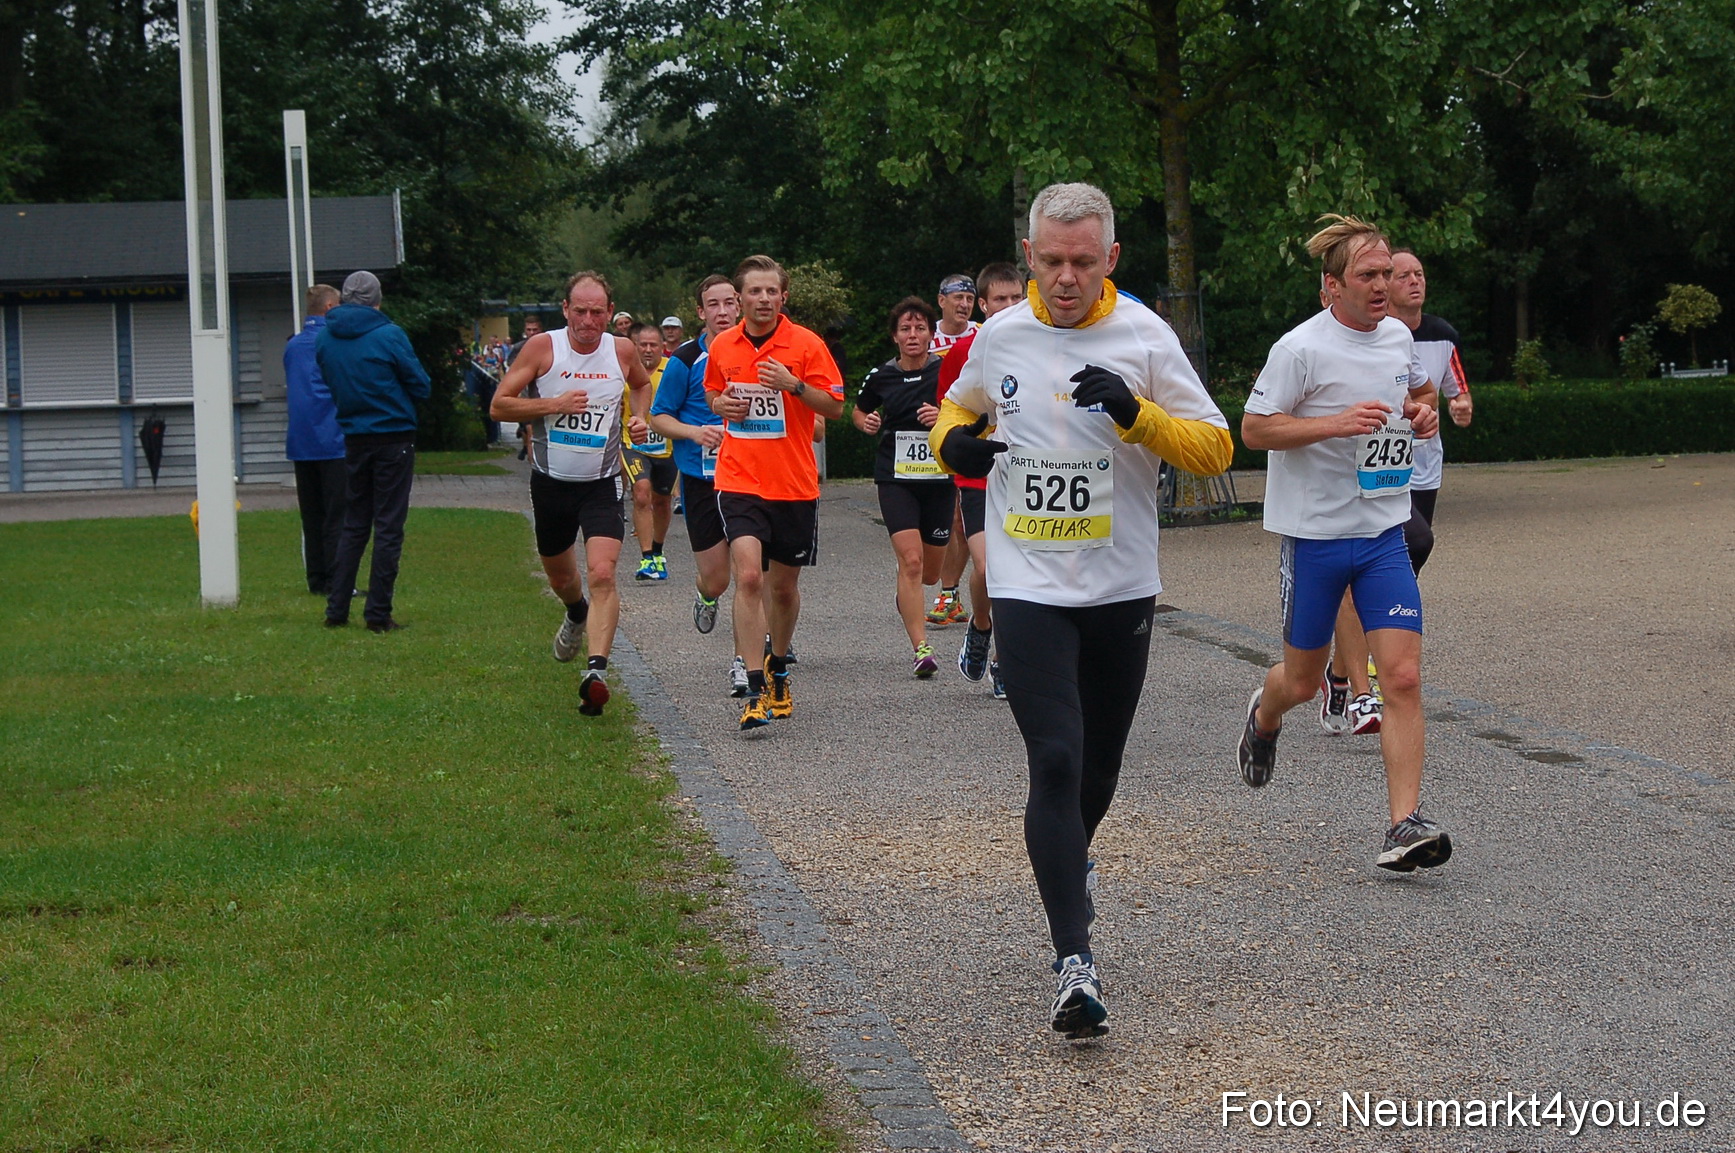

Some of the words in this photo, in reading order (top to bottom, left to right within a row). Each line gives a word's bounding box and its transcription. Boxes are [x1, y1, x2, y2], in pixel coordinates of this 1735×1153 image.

[730, 397, 778, 417] 735
[555, 412, 605, 433] 2697
[741, 422, 771, 431] Andreas
[564, 434, 592, 445] Roland
[905, 465, 937, 473] Marianne
[1010, 456, 1038, 469] PARTL
[1041, 459, 1093, 471] Neumarkt
[1375, 474, 1399, 486] Stefan
[1025, 474, 1091, 512] 526
[1013, 516, 1092, 538] LOTHAR
[1399, 607, 1418, 617] asics
